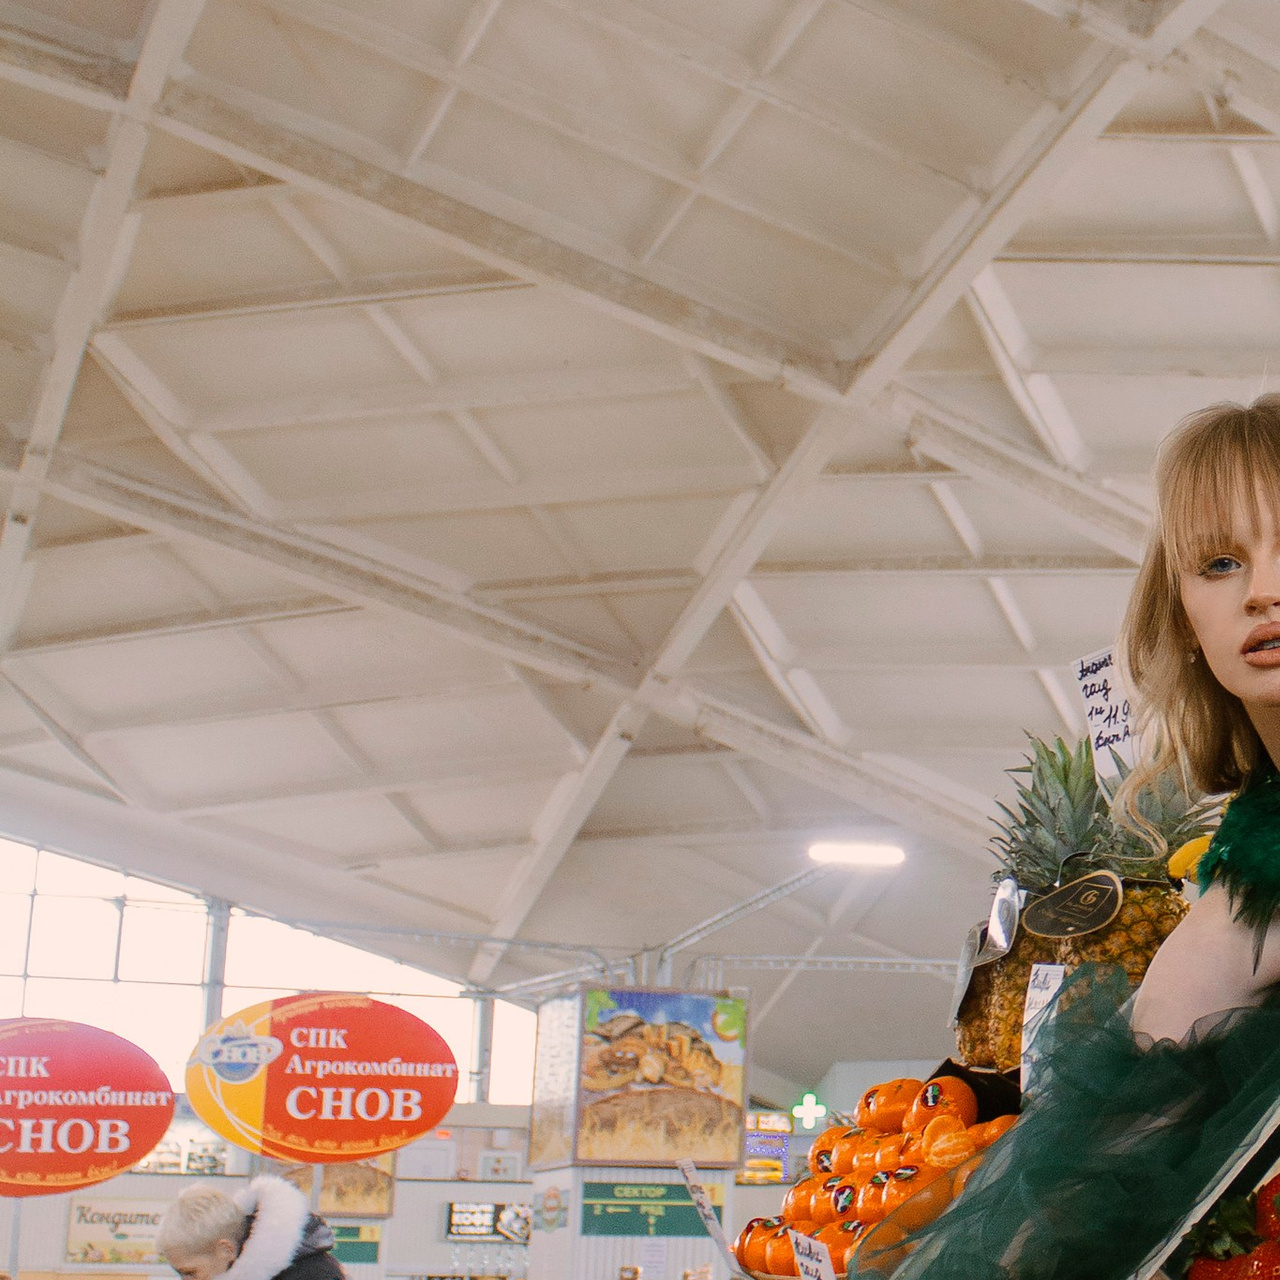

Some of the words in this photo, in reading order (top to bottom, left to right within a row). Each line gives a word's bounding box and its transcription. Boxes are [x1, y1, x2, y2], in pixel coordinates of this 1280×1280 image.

[291, 1027, 349, 1049] СПК
[285, 1055, 457, 1078] Агрокомбинат
[286, 1086, 423, 1122] СНОВ
